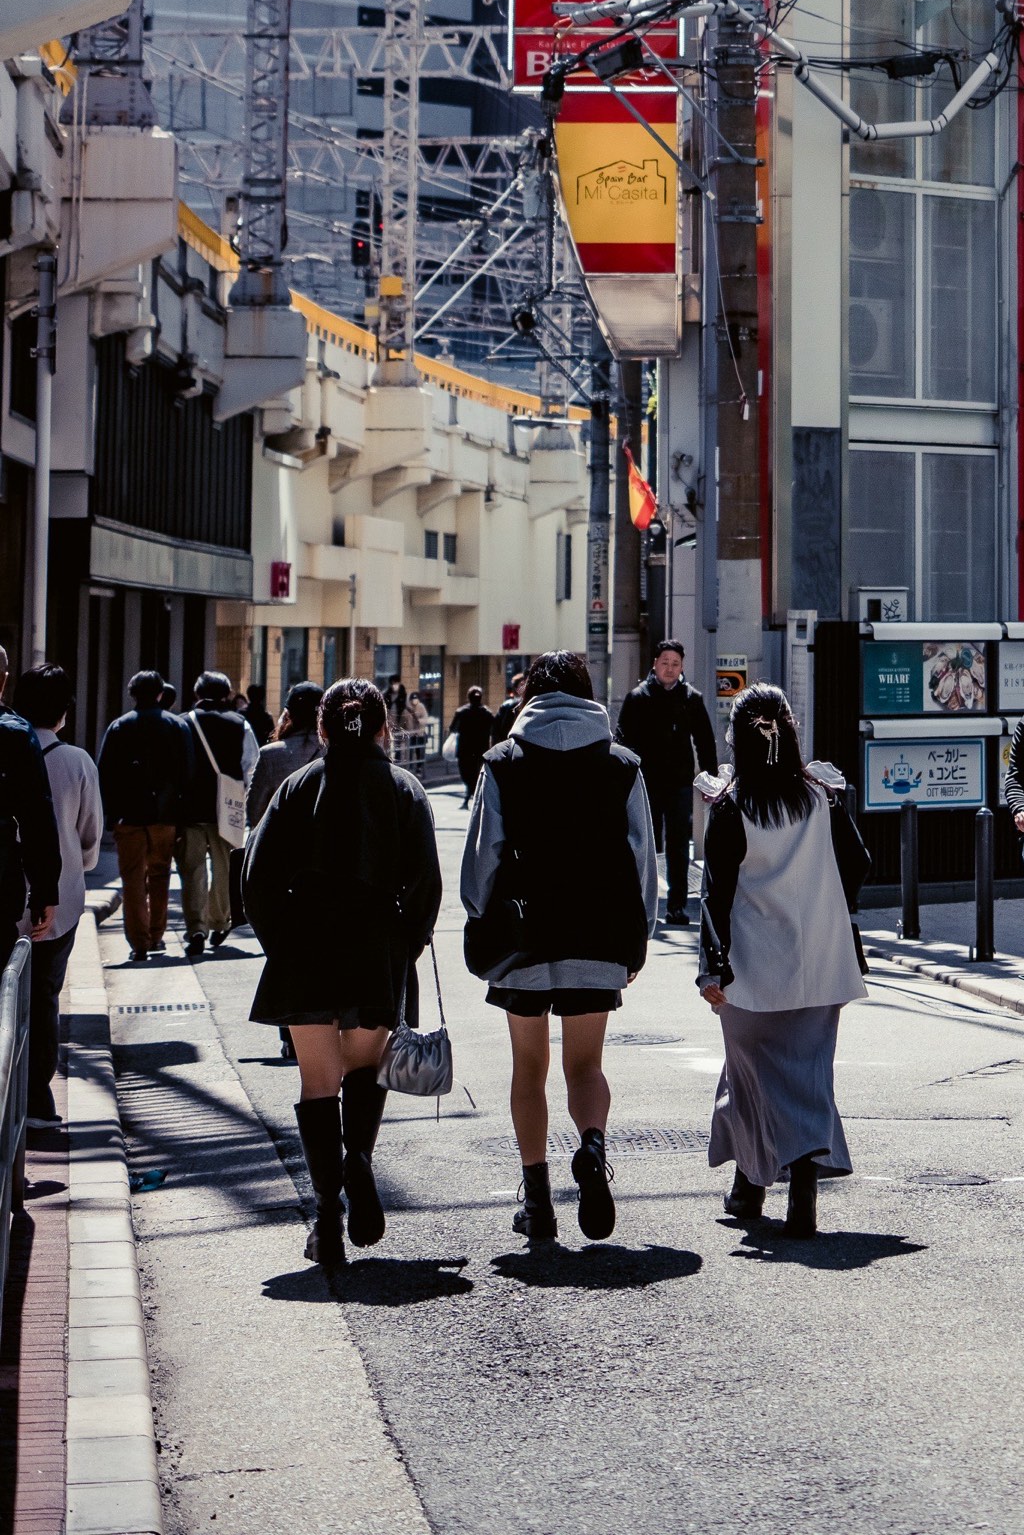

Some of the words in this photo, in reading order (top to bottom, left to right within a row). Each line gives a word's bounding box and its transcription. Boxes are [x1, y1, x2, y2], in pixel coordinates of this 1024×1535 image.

[596, 171, 624, 189] Spain
[626, 172, 649, 185] Bar
[584, 185, 603, 201] Mi
[607, 185, 659, 201] Casita
[878, 674, 911, 684] WHARF
[928, 748, 968, 764] ベーカリー
[928, 769, 935, 779] &
[936, 766, 967, 781] コンビニ
